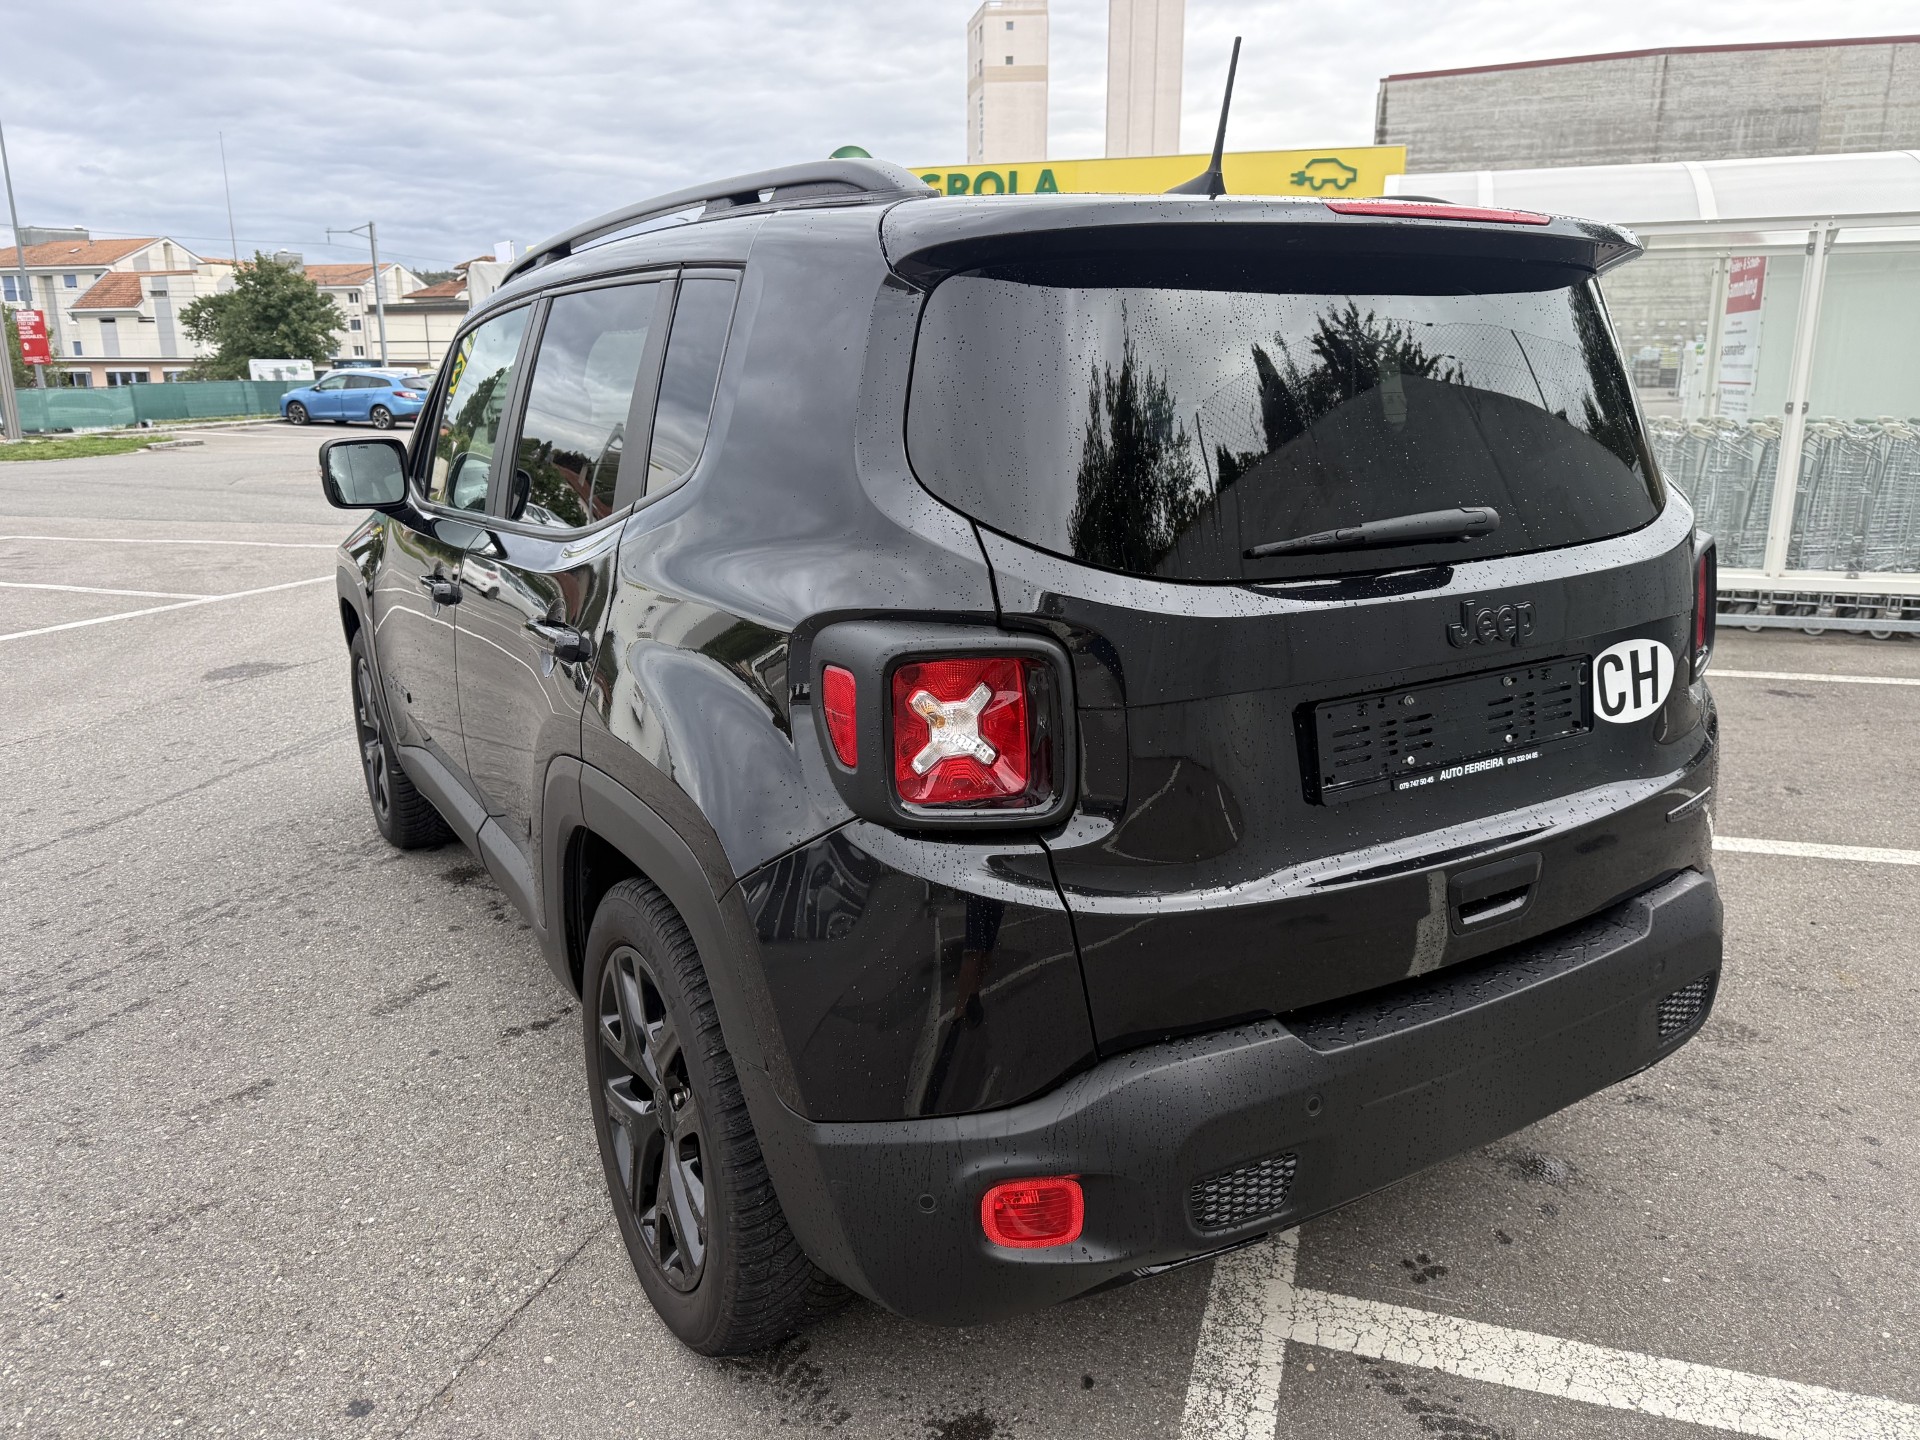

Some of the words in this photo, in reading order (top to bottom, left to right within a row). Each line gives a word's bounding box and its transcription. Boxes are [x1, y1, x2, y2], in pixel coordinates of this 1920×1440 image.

[1447, 600, 1536, 648] Jeep
[1597, 645, 1659, 717] CH
[1440, 766, 1463, 781] AUTO
[1464, 757, 1504, 774] FERREIRA
